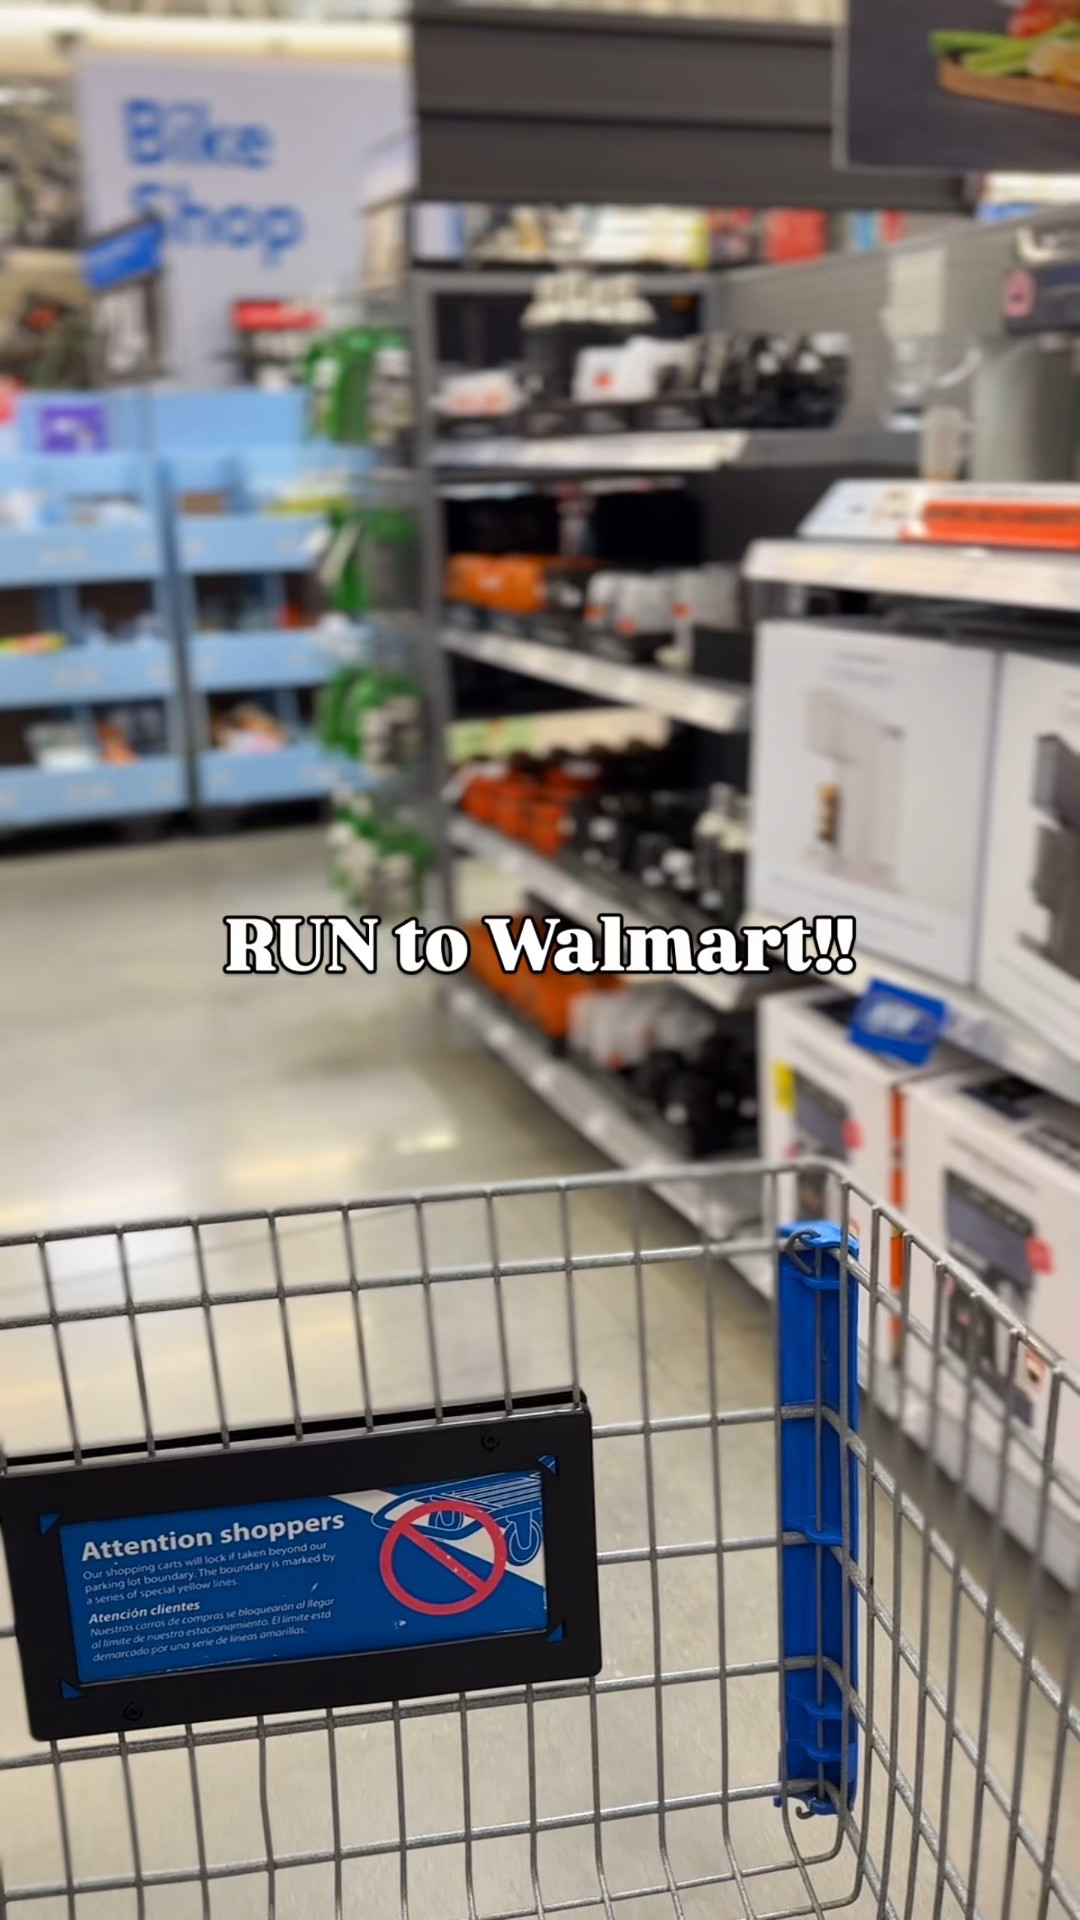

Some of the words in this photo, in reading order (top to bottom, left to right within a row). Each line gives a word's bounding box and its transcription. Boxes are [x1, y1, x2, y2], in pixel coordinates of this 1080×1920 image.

[123, 98, 275, 169] Bike
[81, 1530, 213, 1561] Attention
[220, 1514, 345, 1543] shoppers
[83, 1570, 102, 1580] Our
[106, 1563, 155, 1577] shopping
[157, 1560, 182, 1570] carts
[184, 1556, 203, 1566] will
[205, 1554, 226, 1564] lock
[229, 1551, 235, 1561] if
[238, 1549, 266, 1559] taken
[268, 1542, 307, 1556] beyond
[309, 1542, 327, 1551] our
[85, 1580, 125, 1594] parking
[127, 1577, 141, 1586] lot
[198, 1567, 217, 1577] The
[220, 1561, 269, 1574] boundary
[272, 1560, 280, 1568] is
[282, 1554, 320, 1567] marked
[322, 1553, 336, 1563] by
[95, 1592, 124, 1604] series
[126, 1589, 137, 1599] of
[140, 1584, 175, 1598] special
[177, 1581, 211, 1594] yellow
[213, 1578, 239, 1588] lines.
[88, 1607, 147, 1624] Atención
[150, 1601, 200, 1615] clientes
[90, 1624, 133, 1636] Nuestros
[135, 1620, 165, 1630] carros
[167, 1616, 180, 1626] de
[181, 1611, 224, 1624] compras
[226, 1610, 236, 1619] se
[238, 1601, 294, 1617] bloquearán
[296, 1600, 305, 1610] al
[307, 1598, 335, 1609] llegar
[91, 1640, 101, 1650] al
[133, 1634, 145, 1644] de
[147, 1629, 184, 1641] nuestro
[186, 1618, 270, 1636] estacionamiento.
[271, 1615, 281, 1625] El
[311, 1609, 332, 1620] está
[93, 1646, 150, 1662] demarcado
[151, 1644, 168, 1655] por
[170, 1642, 190, 1651] una
[191, 1637, 214, 1648] serie
[215, 1634, 228, 1645] de
[259, 1625, 307, 1639] amarillas.
